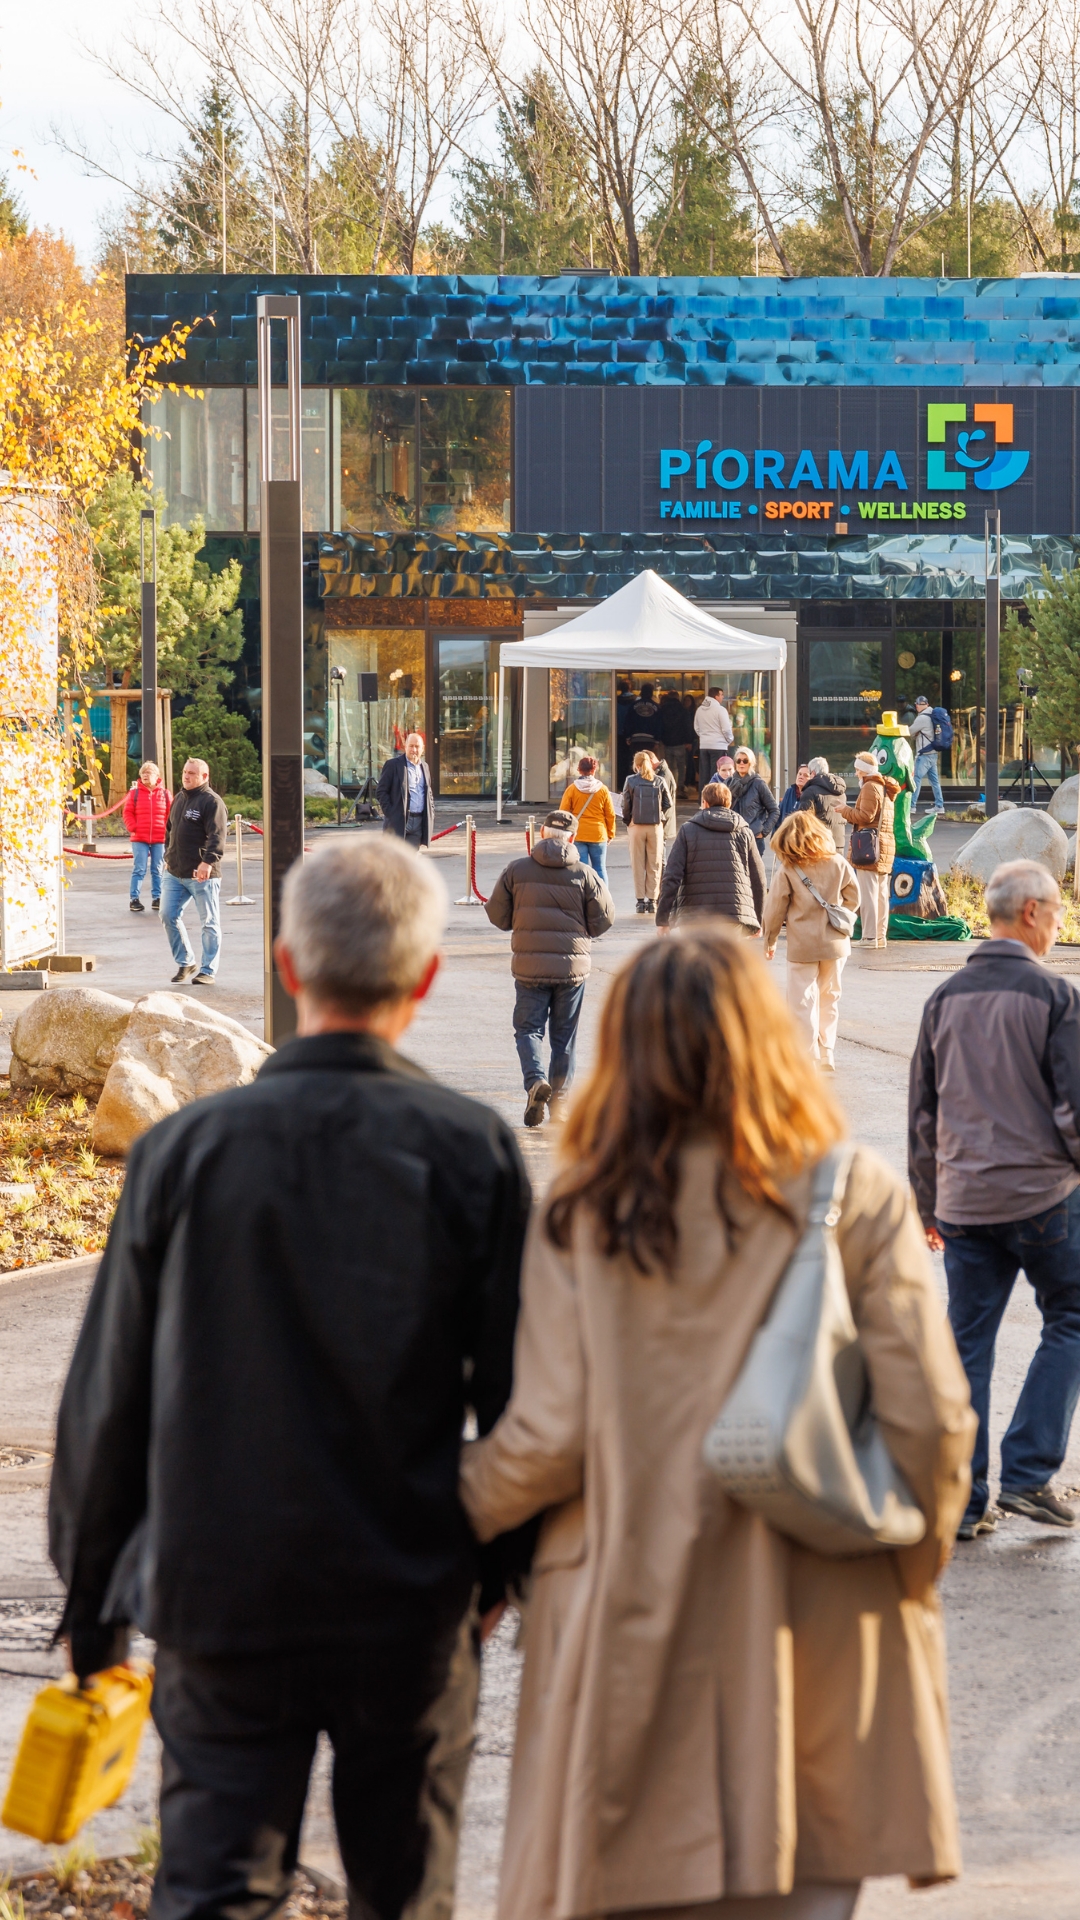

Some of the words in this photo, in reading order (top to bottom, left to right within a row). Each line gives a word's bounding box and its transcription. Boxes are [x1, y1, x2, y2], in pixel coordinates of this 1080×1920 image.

[660, 501, 742, 519] FAMILIE
[765, 502, 833, 519] SPORT
[858, 502, 966, 520] WELLNESS
